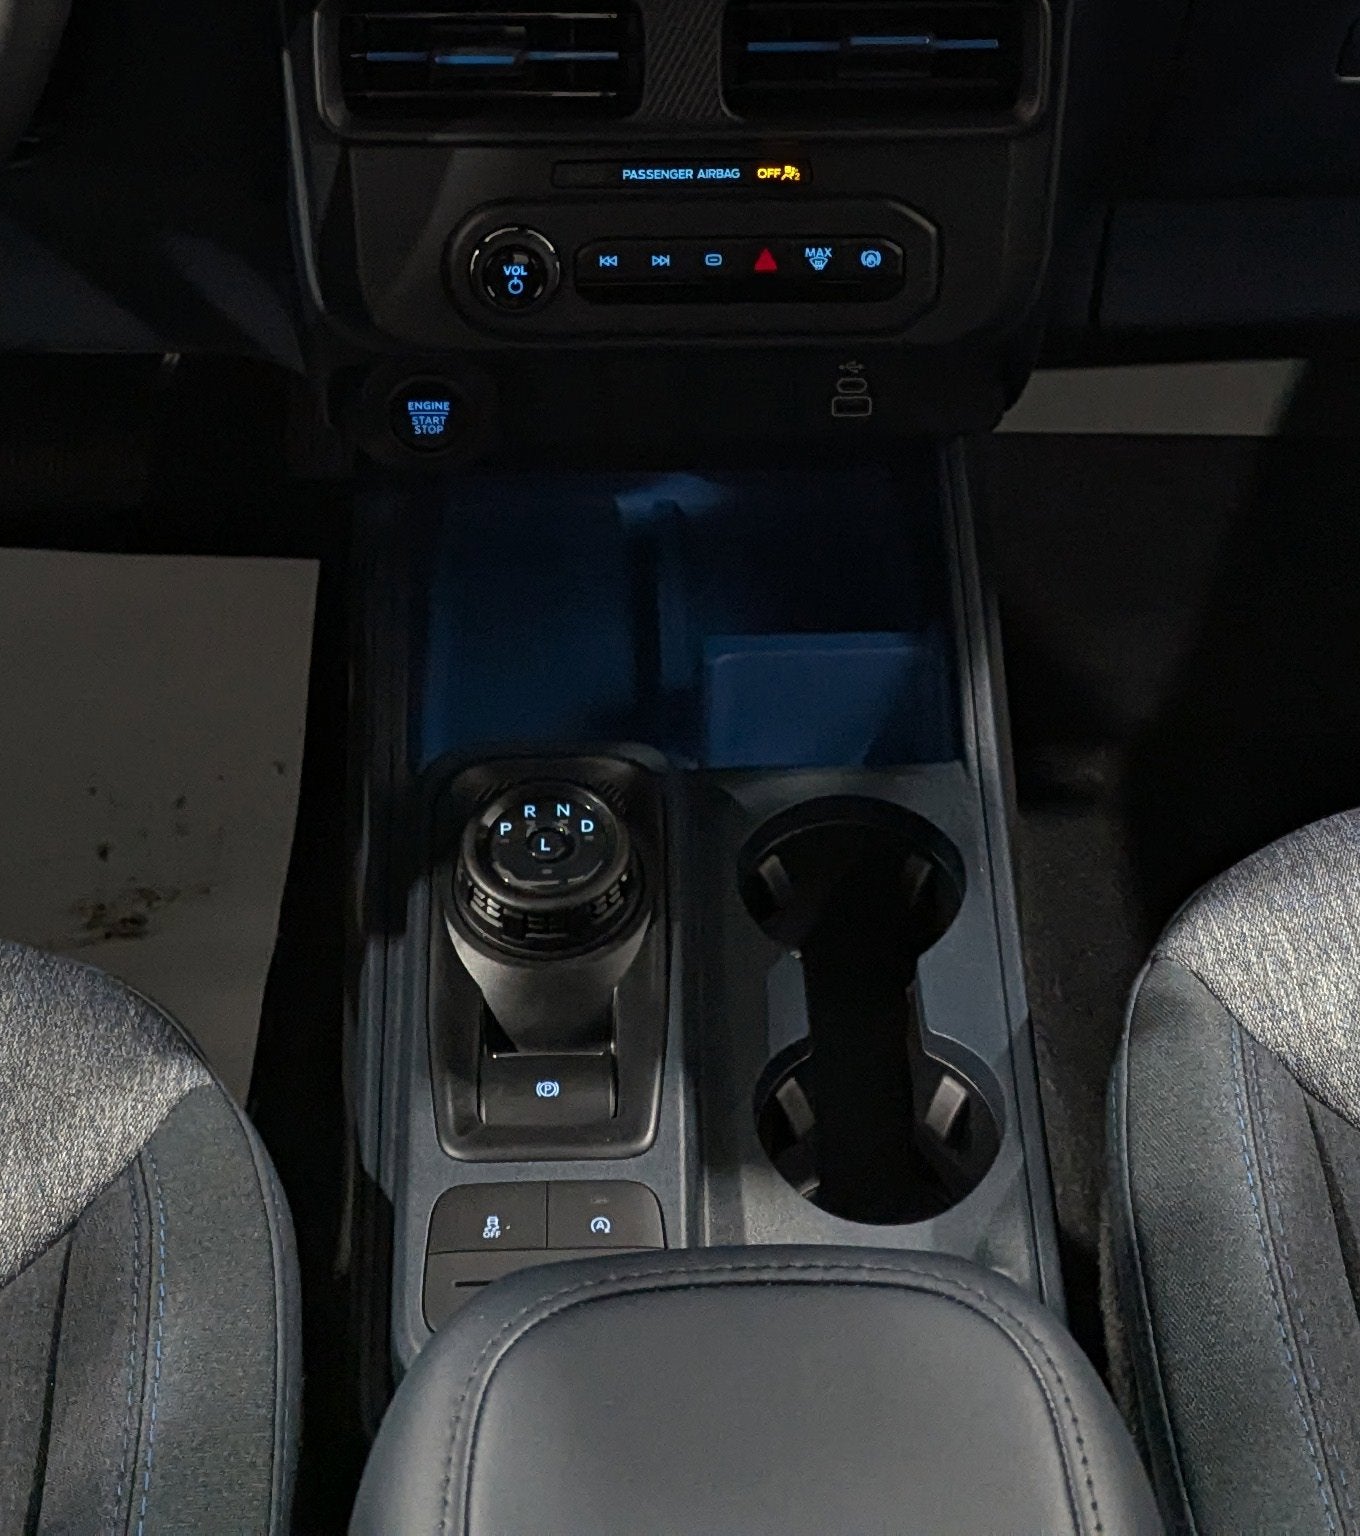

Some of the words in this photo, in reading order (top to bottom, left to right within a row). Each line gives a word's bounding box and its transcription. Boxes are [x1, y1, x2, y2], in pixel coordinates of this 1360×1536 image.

[622, 169, 693, 180] PASSENGER
[697, 168, 740, 179] AIRBAG
[757, 168, 781, 179] OFF
[804, 247, 833, 258] MAX
[503, 265, 528, 276] VOL
[407, 401, 450, 411] ENGINE
[412, 415, 447, 425] START
[414, 424, 444, 435] STOP
[500, 822, 512, 836] P
[524, 805, 537, 818] R
[556, 803, 570, 817] N
[580, 819, 594, 833] D
[540, 838, 551, 852] L
[482, 1230, 501, 1239] OFF
